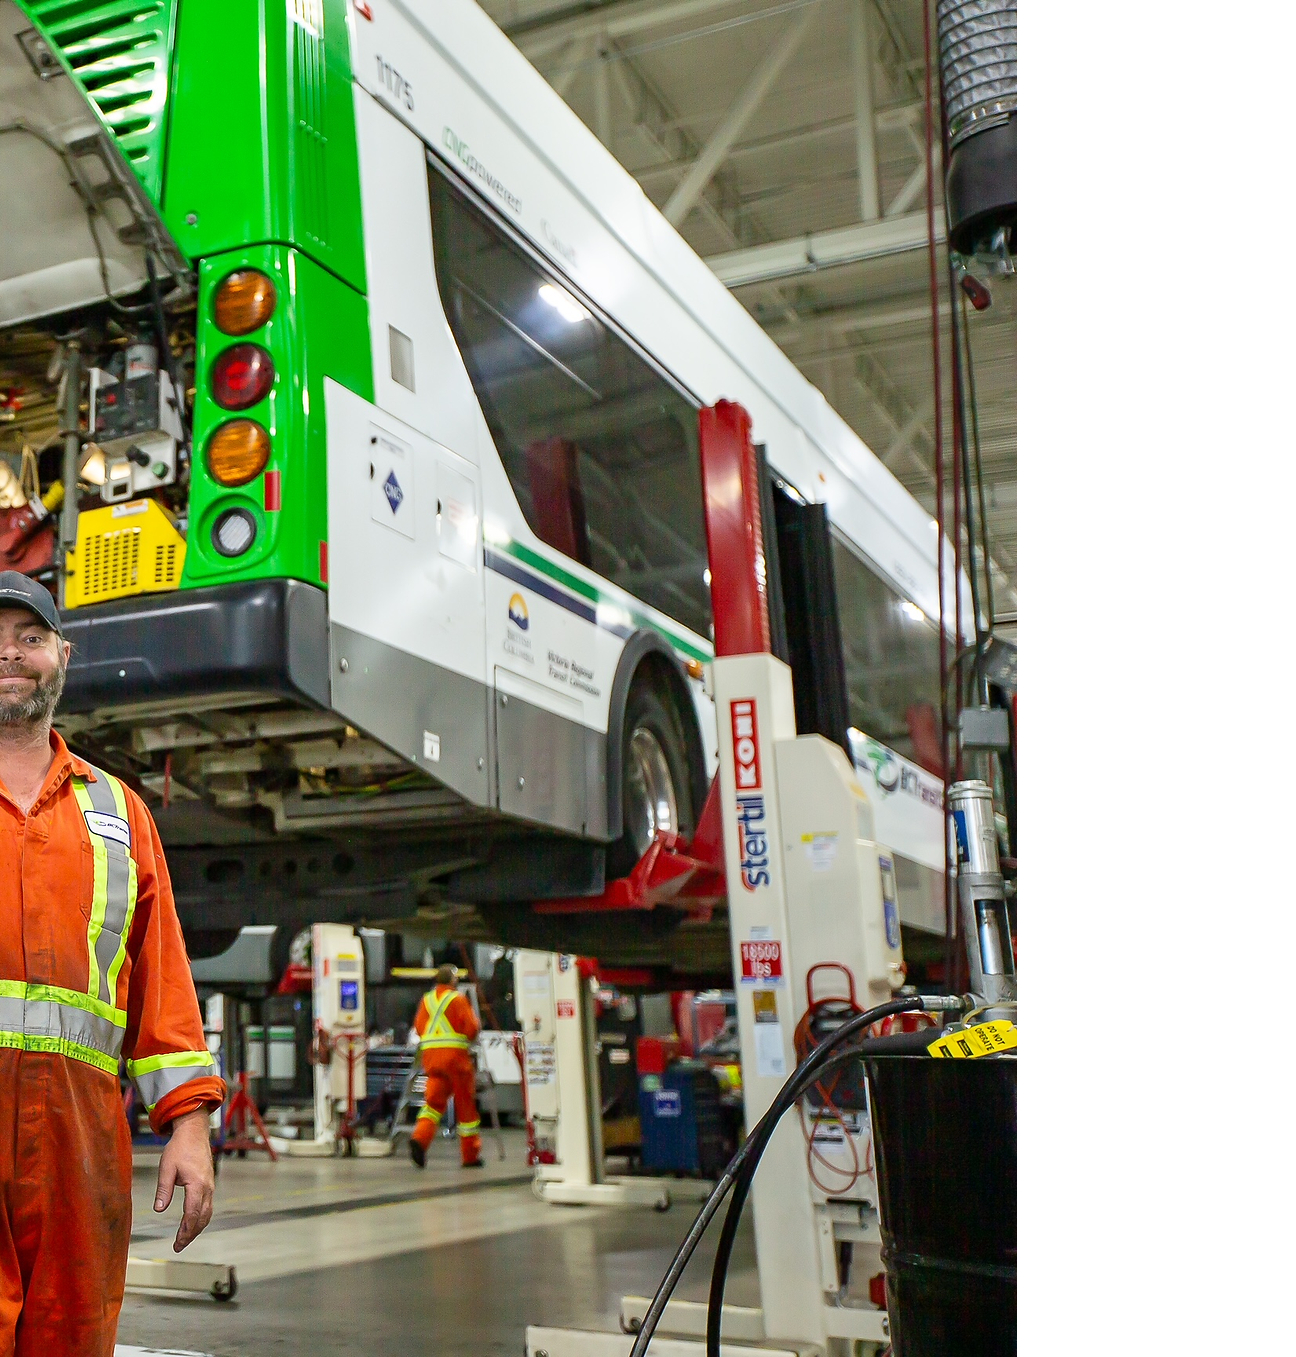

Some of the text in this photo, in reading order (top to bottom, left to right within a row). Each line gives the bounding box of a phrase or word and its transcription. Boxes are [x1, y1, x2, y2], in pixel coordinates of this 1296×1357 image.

[375, 54, 414, 112] 1175
[735, 702, 757, 788] KONI
[736, 795, 770, 887] stertil
[751, 960, 772, 977] lbs
[974, 1027, 994, 1051] OPERATE
[987, 1025, 1005, 1045] DO NOT
